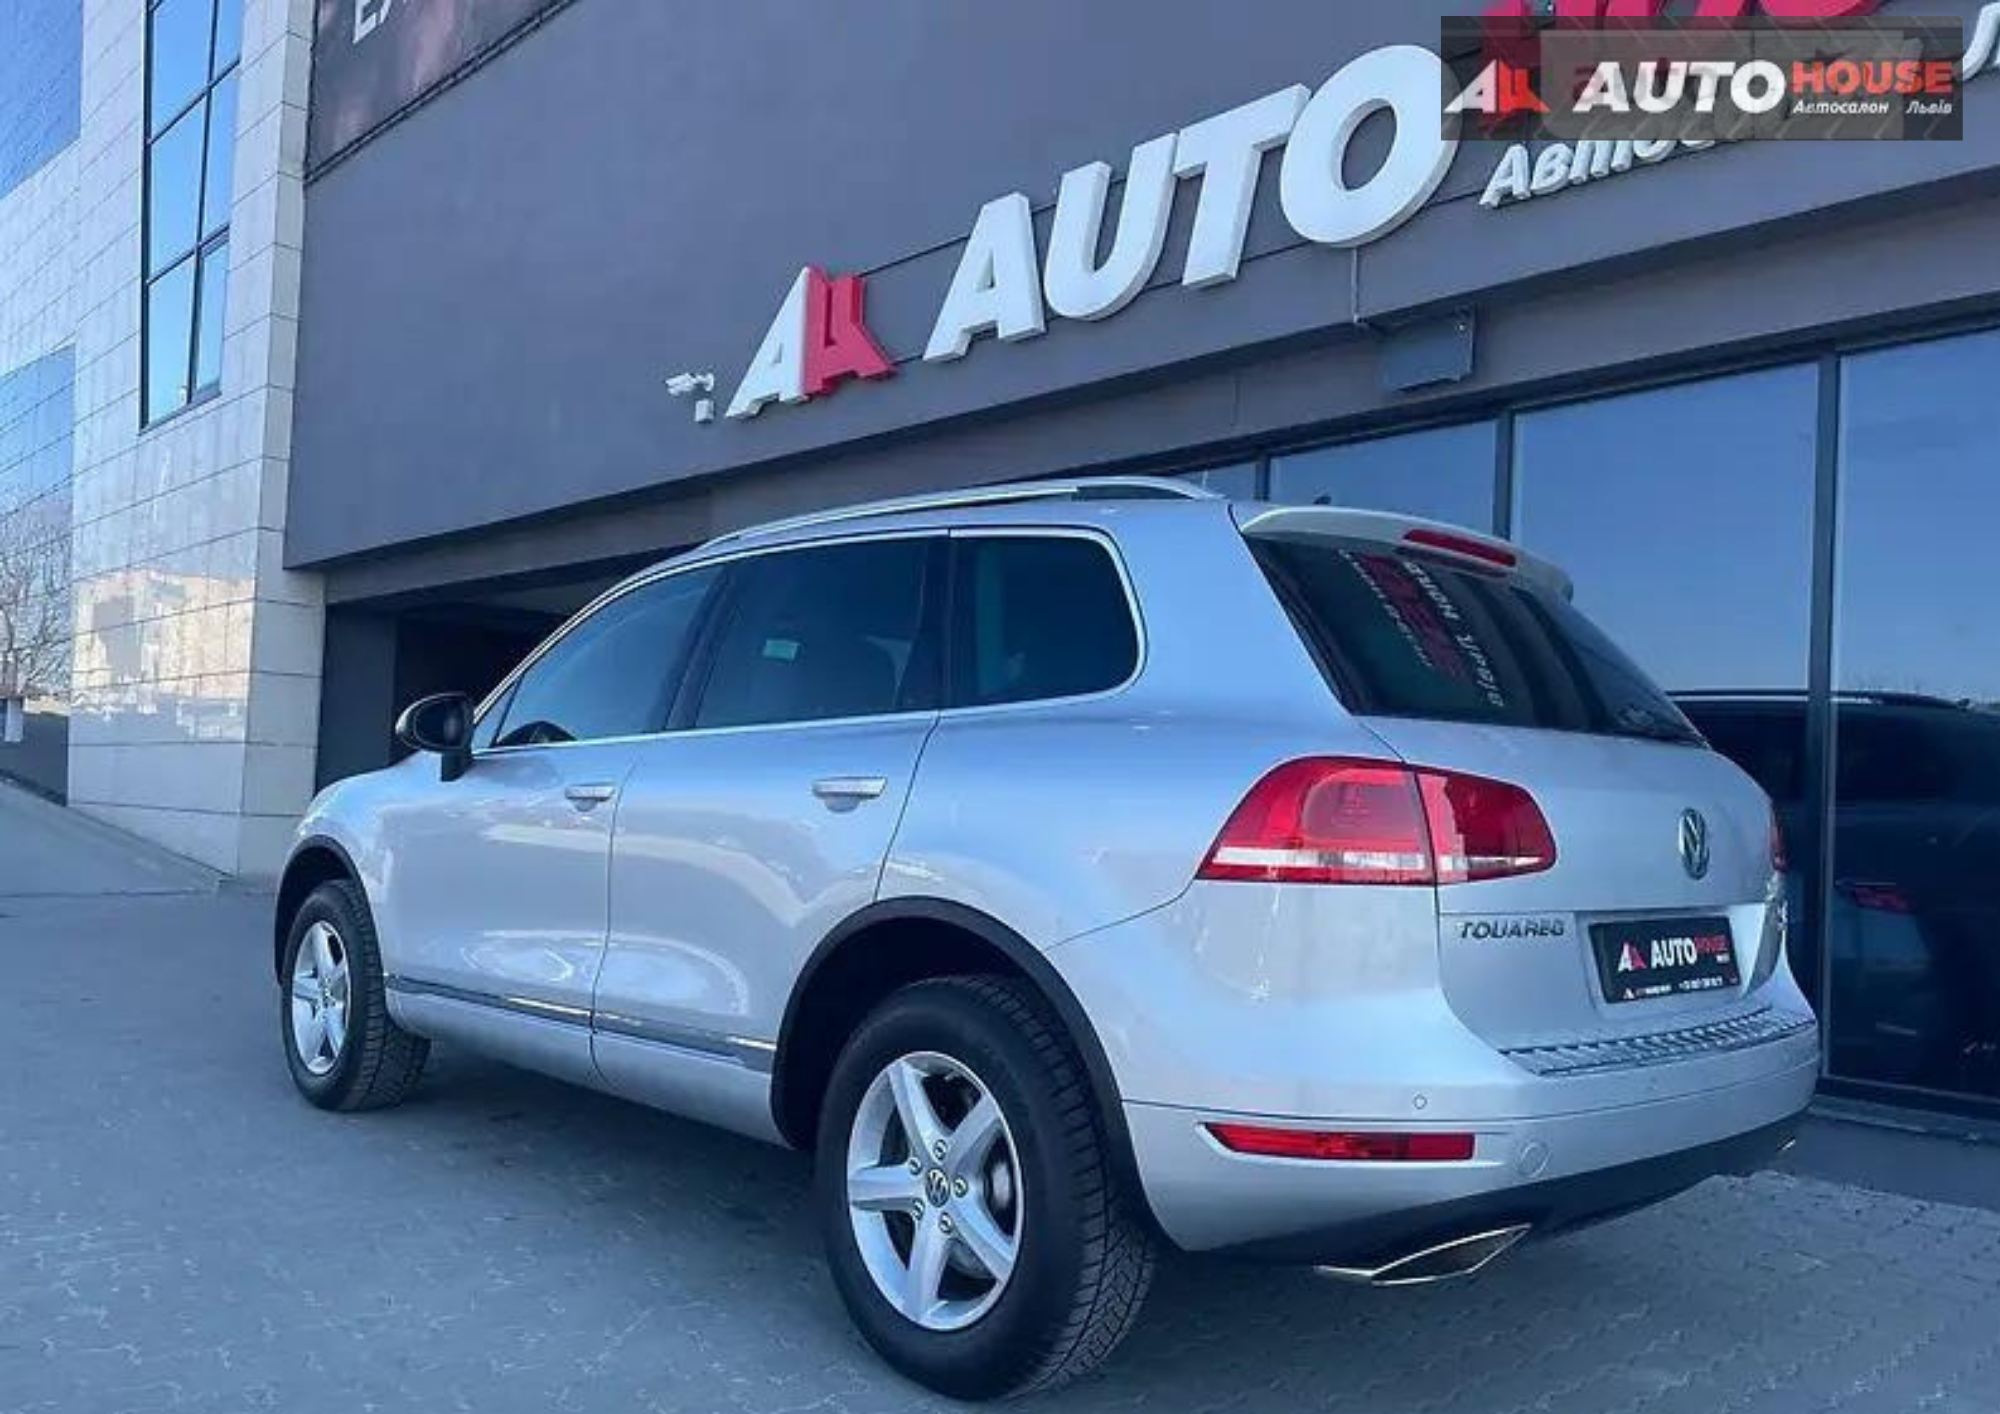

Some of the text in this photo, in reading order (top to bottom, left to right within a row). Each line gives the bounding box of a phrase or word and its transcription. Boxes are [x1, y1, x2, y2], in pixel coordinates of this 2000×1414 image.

[922, 44, 1459, 364] AUTO
[1458, 920, 1565, 940] TOUAREG
[1650, 936, 1698, 970] AUTO
